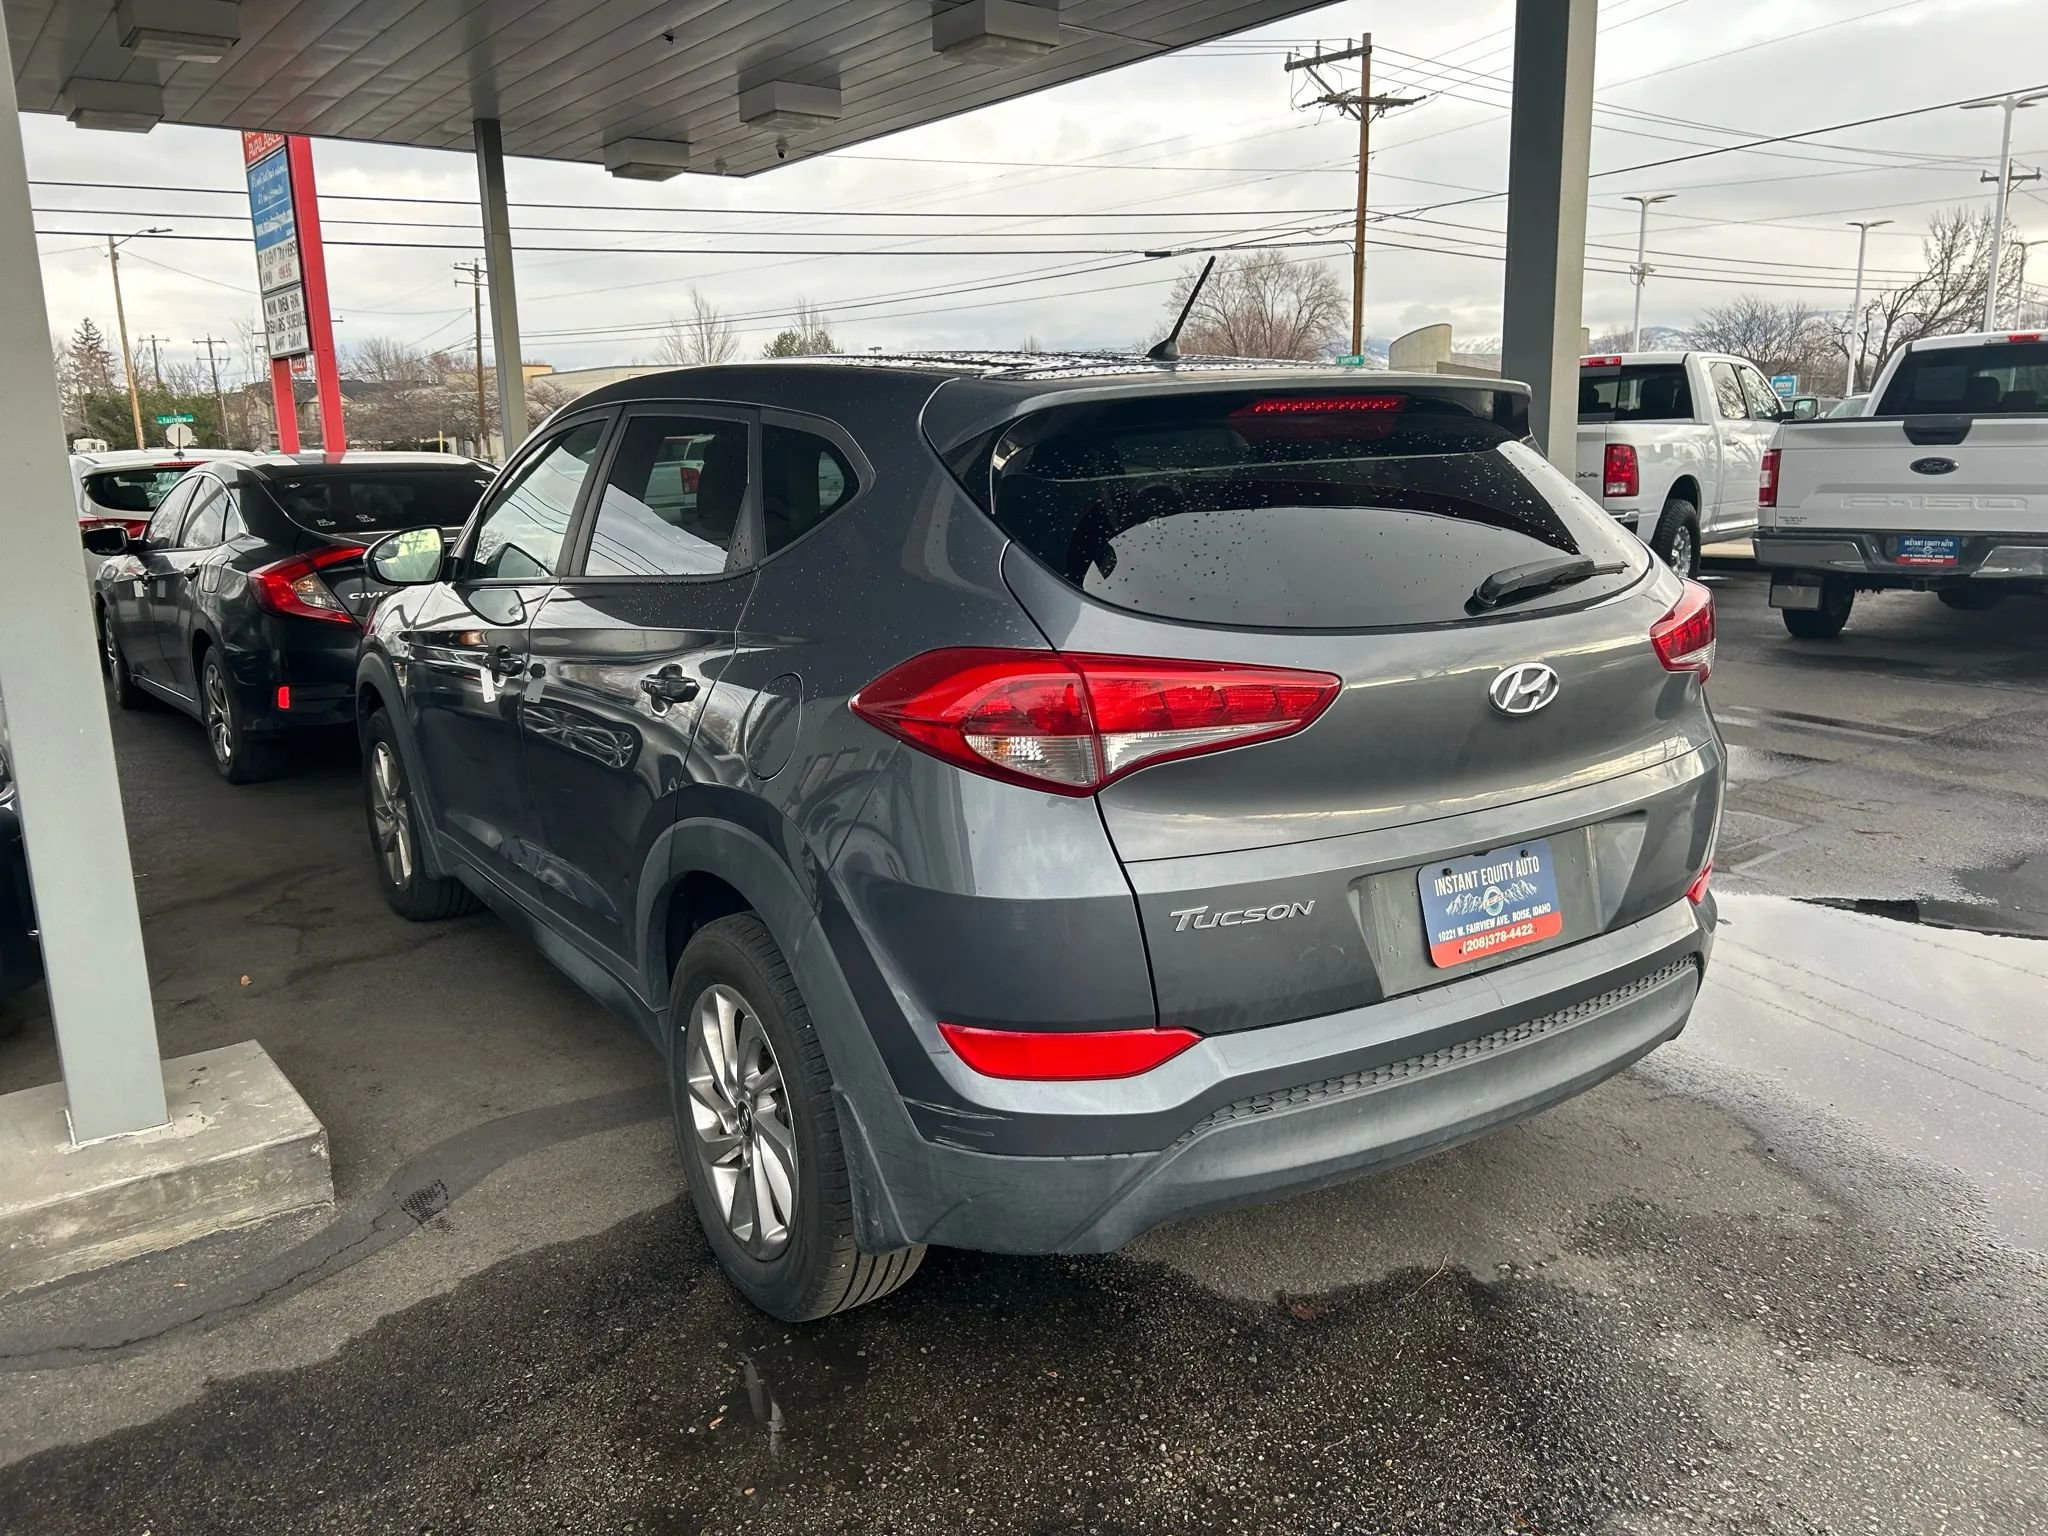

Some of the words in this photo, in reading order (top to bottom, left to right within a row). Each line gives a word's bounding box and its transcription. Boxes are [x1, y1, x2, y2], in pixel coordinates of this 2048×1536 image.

[1840, 496, 2028, 511] F-150
[1434, 871, 1478, 896] INSTANT
[1482, 863, 1514, 886] EQUITY
[1516, 856, 1540, 876] AUTO
[1170, 900, 1316, 932] TUCSON
[1438, 930, 1456, 942] 10221
[1466, 920, 1496, 934] FAIRVIEW
[1533, 903, 1551, 916] IDAHO
[1462, 924, 1534, 956] (208)378-4422
